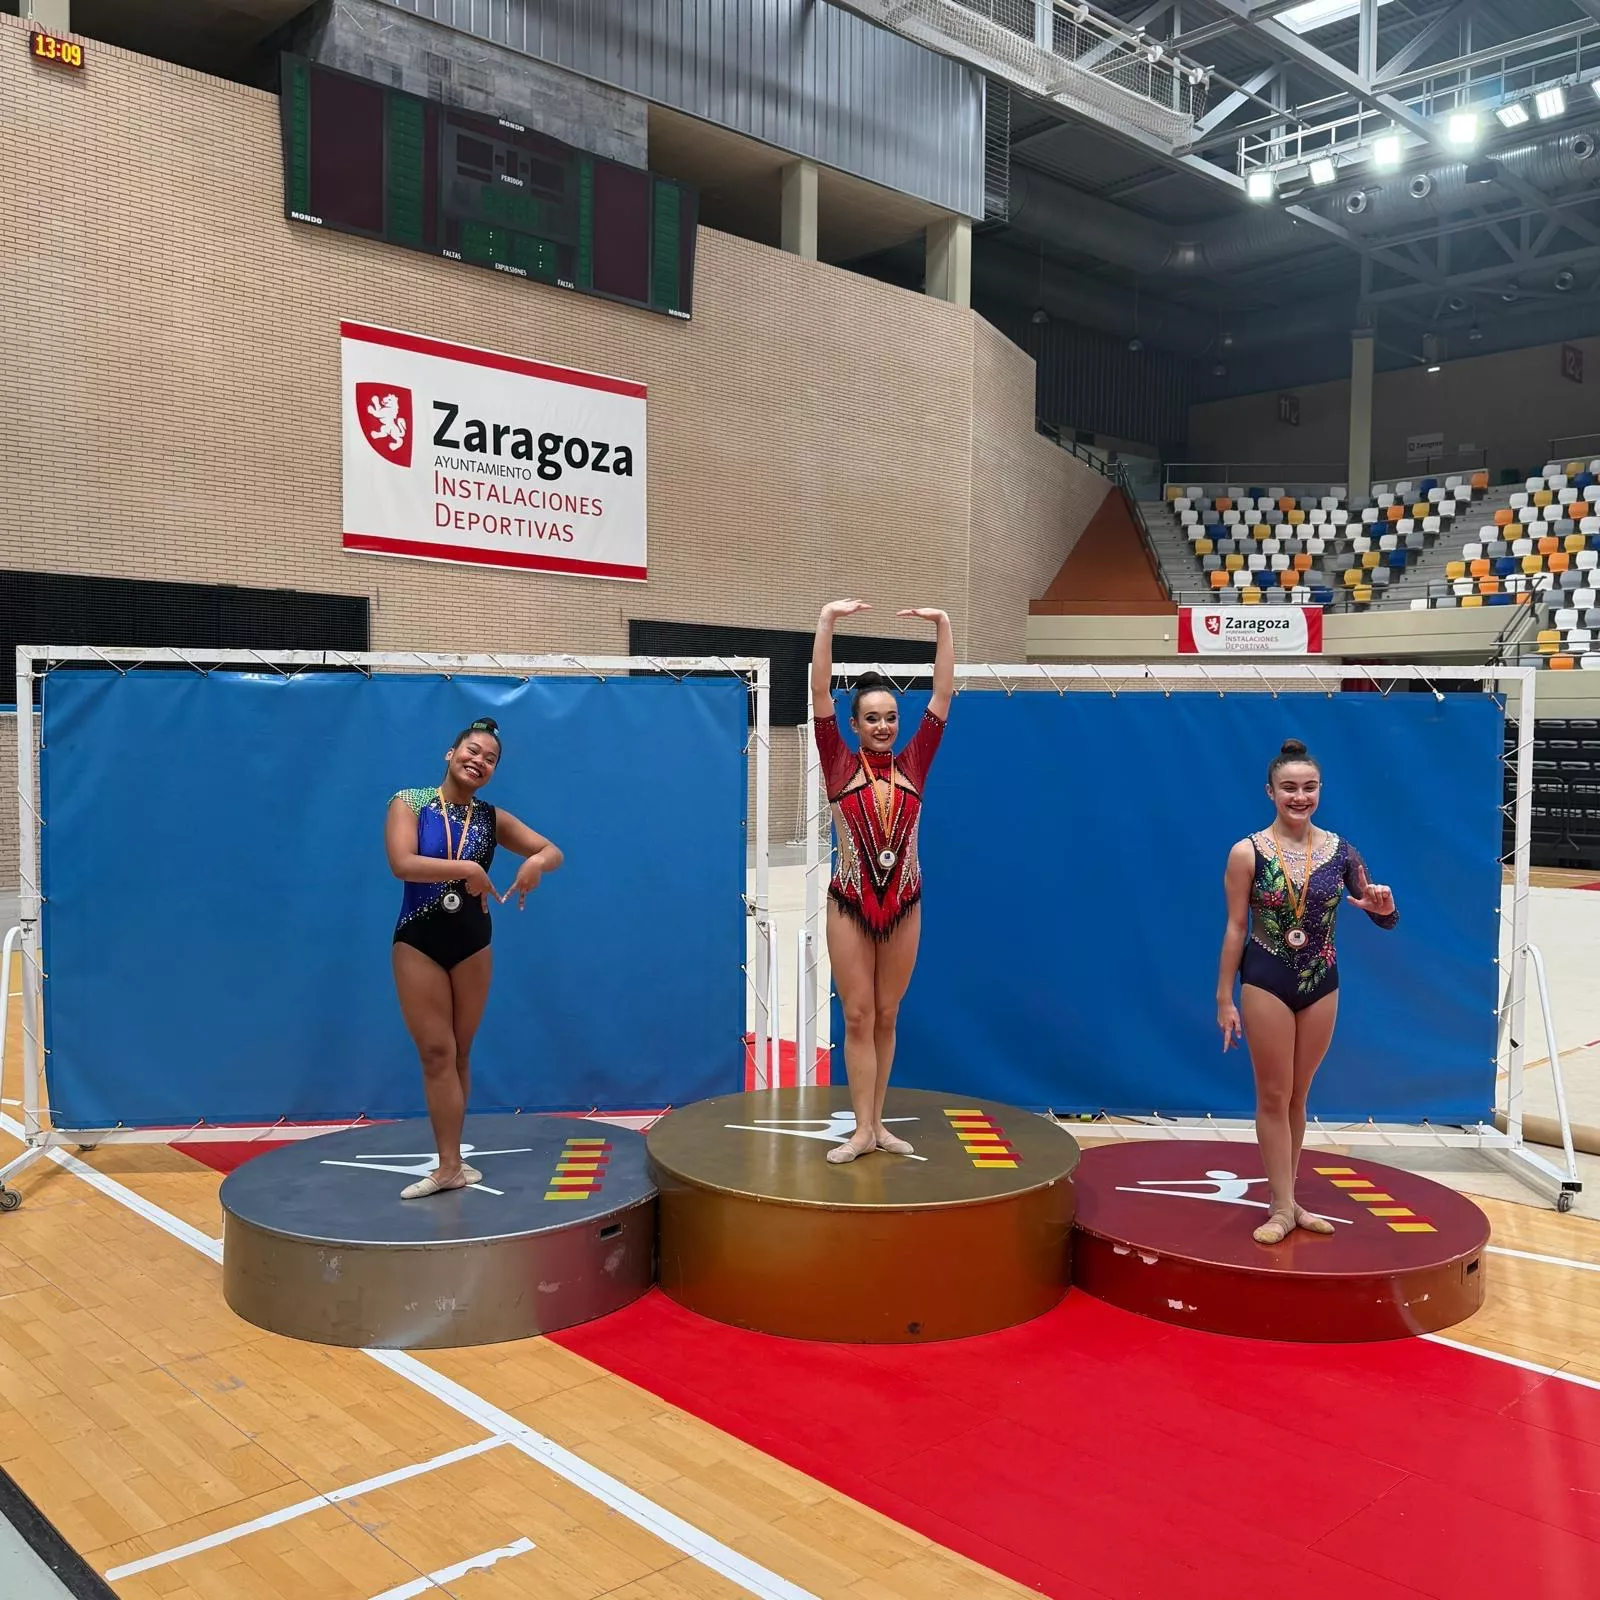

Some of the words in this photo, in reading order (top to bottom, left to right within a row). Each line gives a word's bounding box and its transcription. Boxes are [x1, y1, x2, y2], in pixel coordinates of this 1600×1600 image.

[35, 34, 81, 66] 13:09
[498, 118, 525, 132] MONDO
[500, 174, 524, 187] PERIODO
[291, 211, 323, 224] MONDO
[442, 249, 461, 260] FALTAS
[494, 262, 527, 276] EXPULSIONES
[557, 279, 575, 289] FALTAS
[668, 308, 691, 319] MONDO
[433, 400, 633, 481] Zaragoza
[434, 455, 532, 481] AYUNTAMIENTO
[434, 470, 603, 517] INSTALACIONES
[435, 502, 574, 543] DEPORTIVAS
[1225, 617, 1289, 632] Zaragoza
